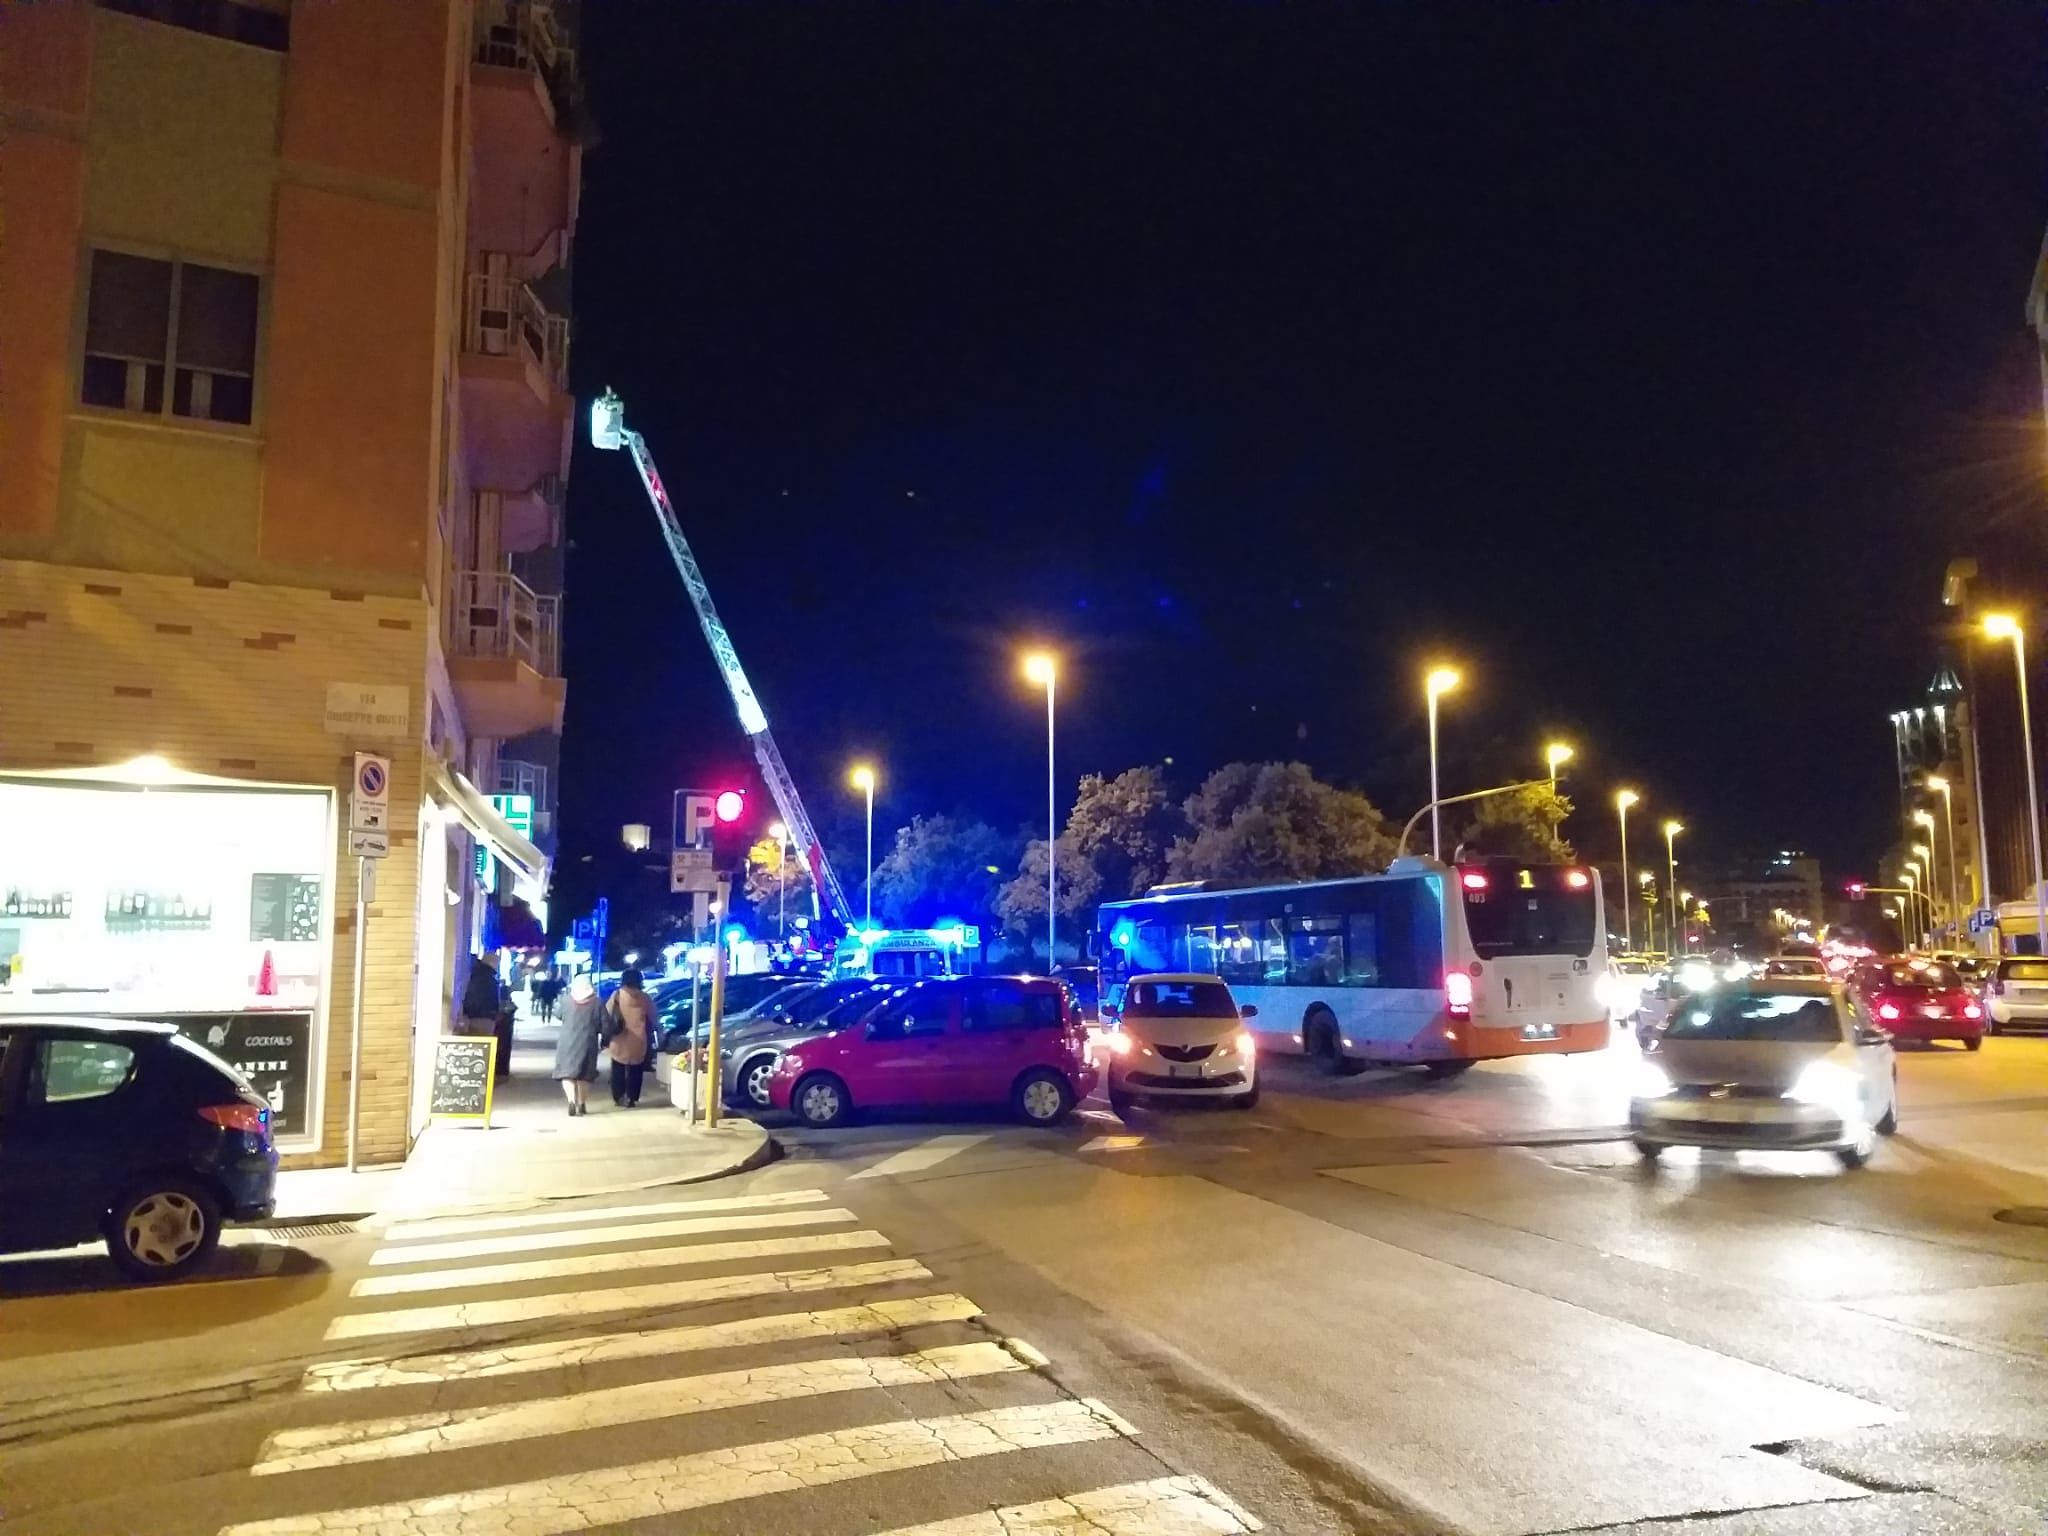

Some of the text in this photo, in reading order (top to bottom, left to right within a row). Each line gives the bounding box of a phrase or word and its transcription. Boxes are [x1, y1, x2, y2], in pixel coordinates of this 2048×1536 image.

[685, 796, 716, 844] P
[1519, 870, 1536, 888] 1
[1980, 911, 1992, 925] P
[578, 921, 591, 938] P
[965, 928, 975, 941] P
[245, 1035, 293, 1047] COCKTAILS
